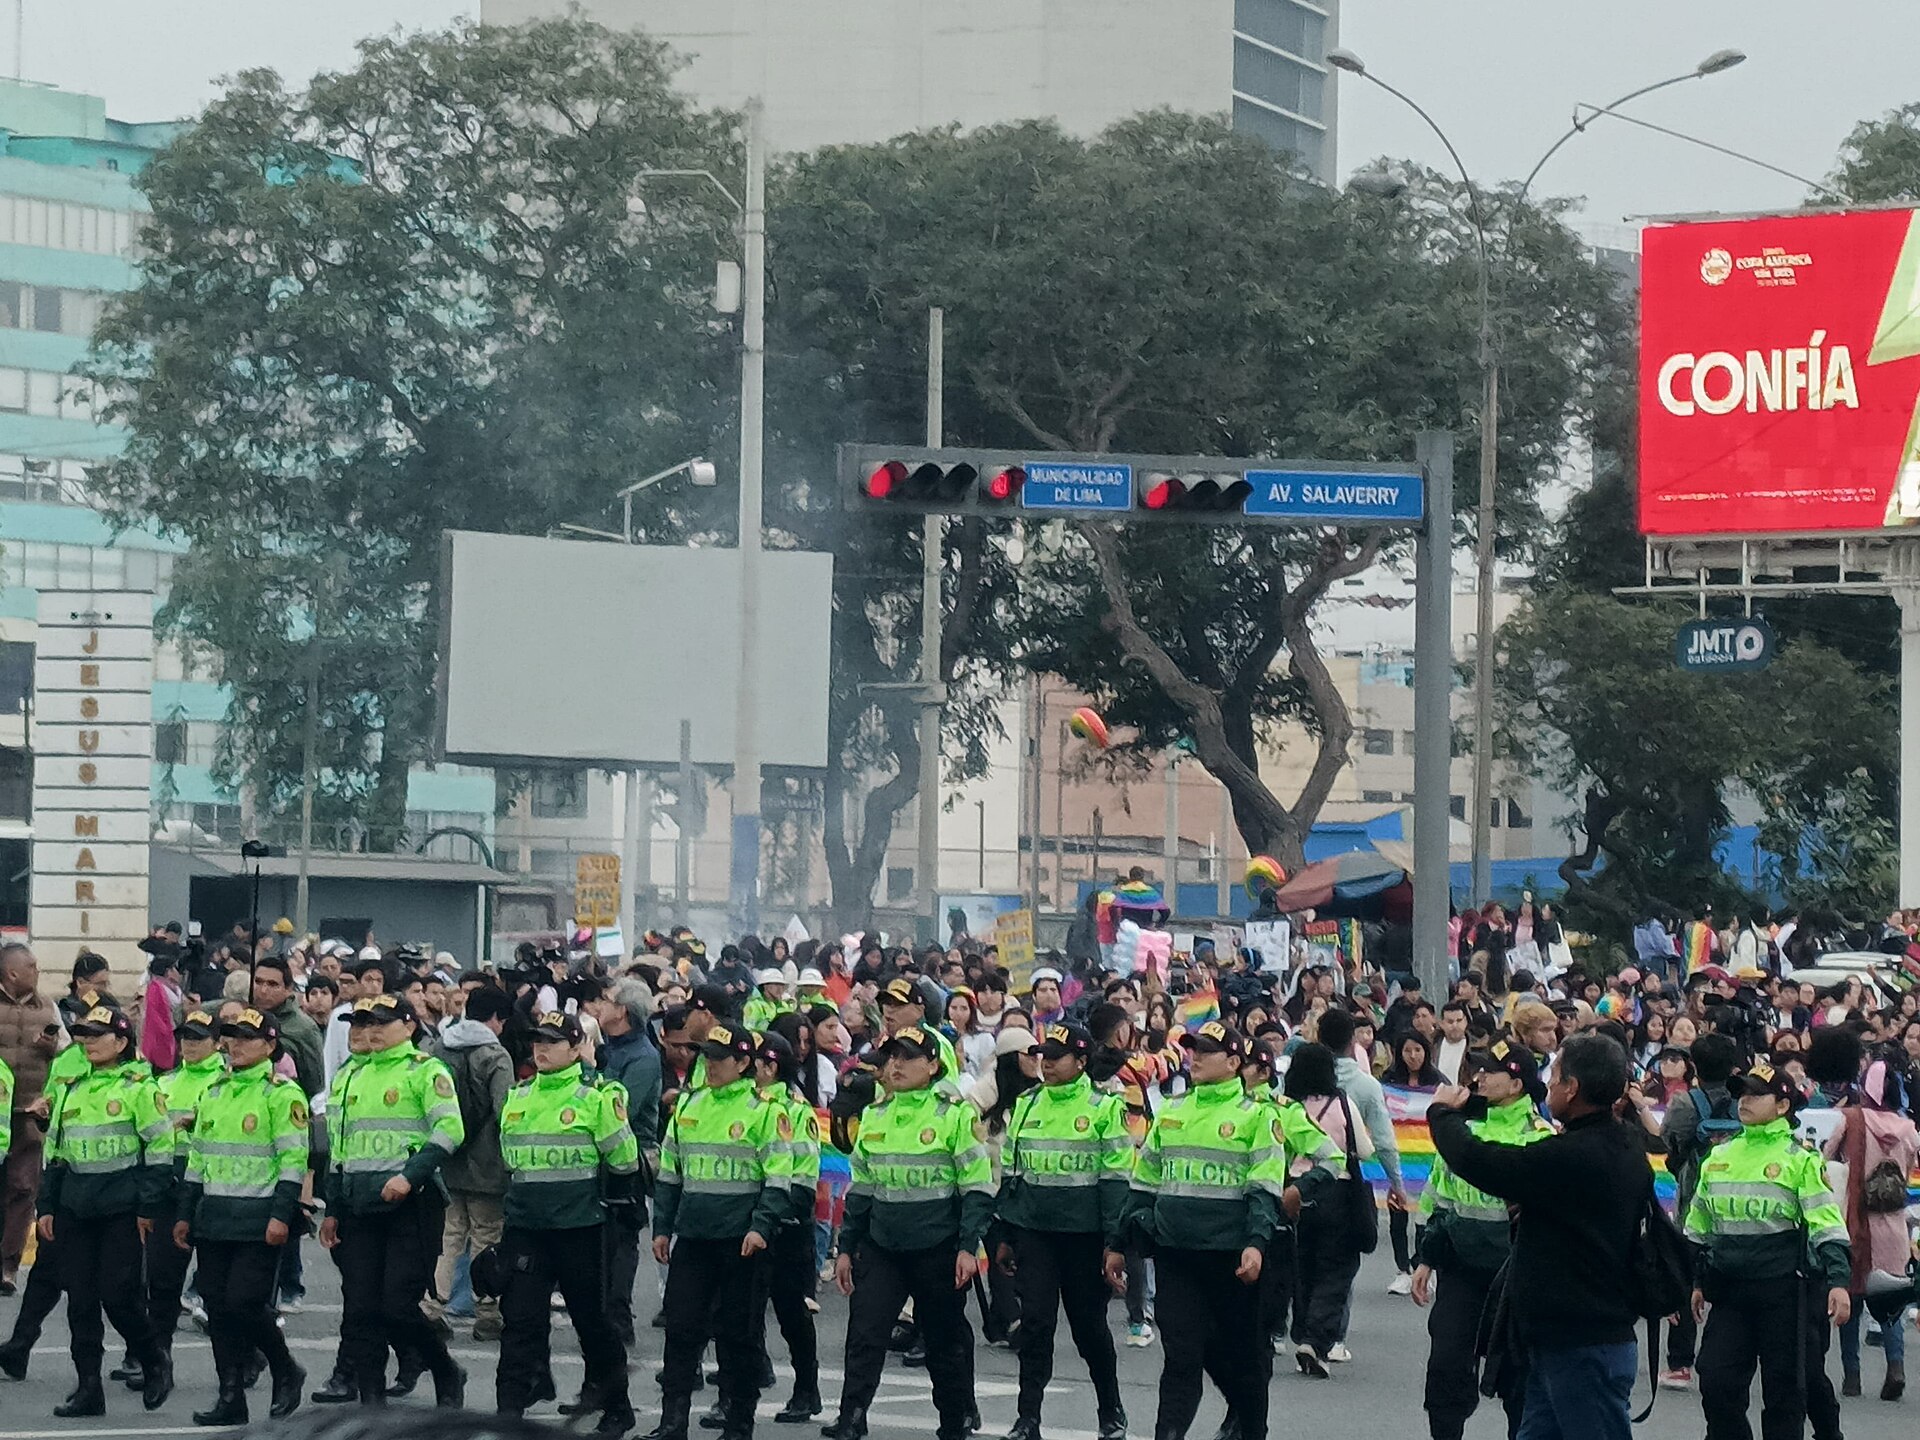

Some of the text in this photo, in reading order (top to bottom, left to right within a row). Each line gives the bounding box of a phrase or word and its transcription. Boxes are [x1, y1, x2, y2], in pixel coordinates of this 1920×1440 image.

[1658, 330, 1859, 416] CONFÍA
[1031, 466, 1123, 486] MUNICIPALIDAD
[1054, 486, 1103, 504] DE LIMA
[1268, 483, 1400, 506] AV. SALAVERRY
